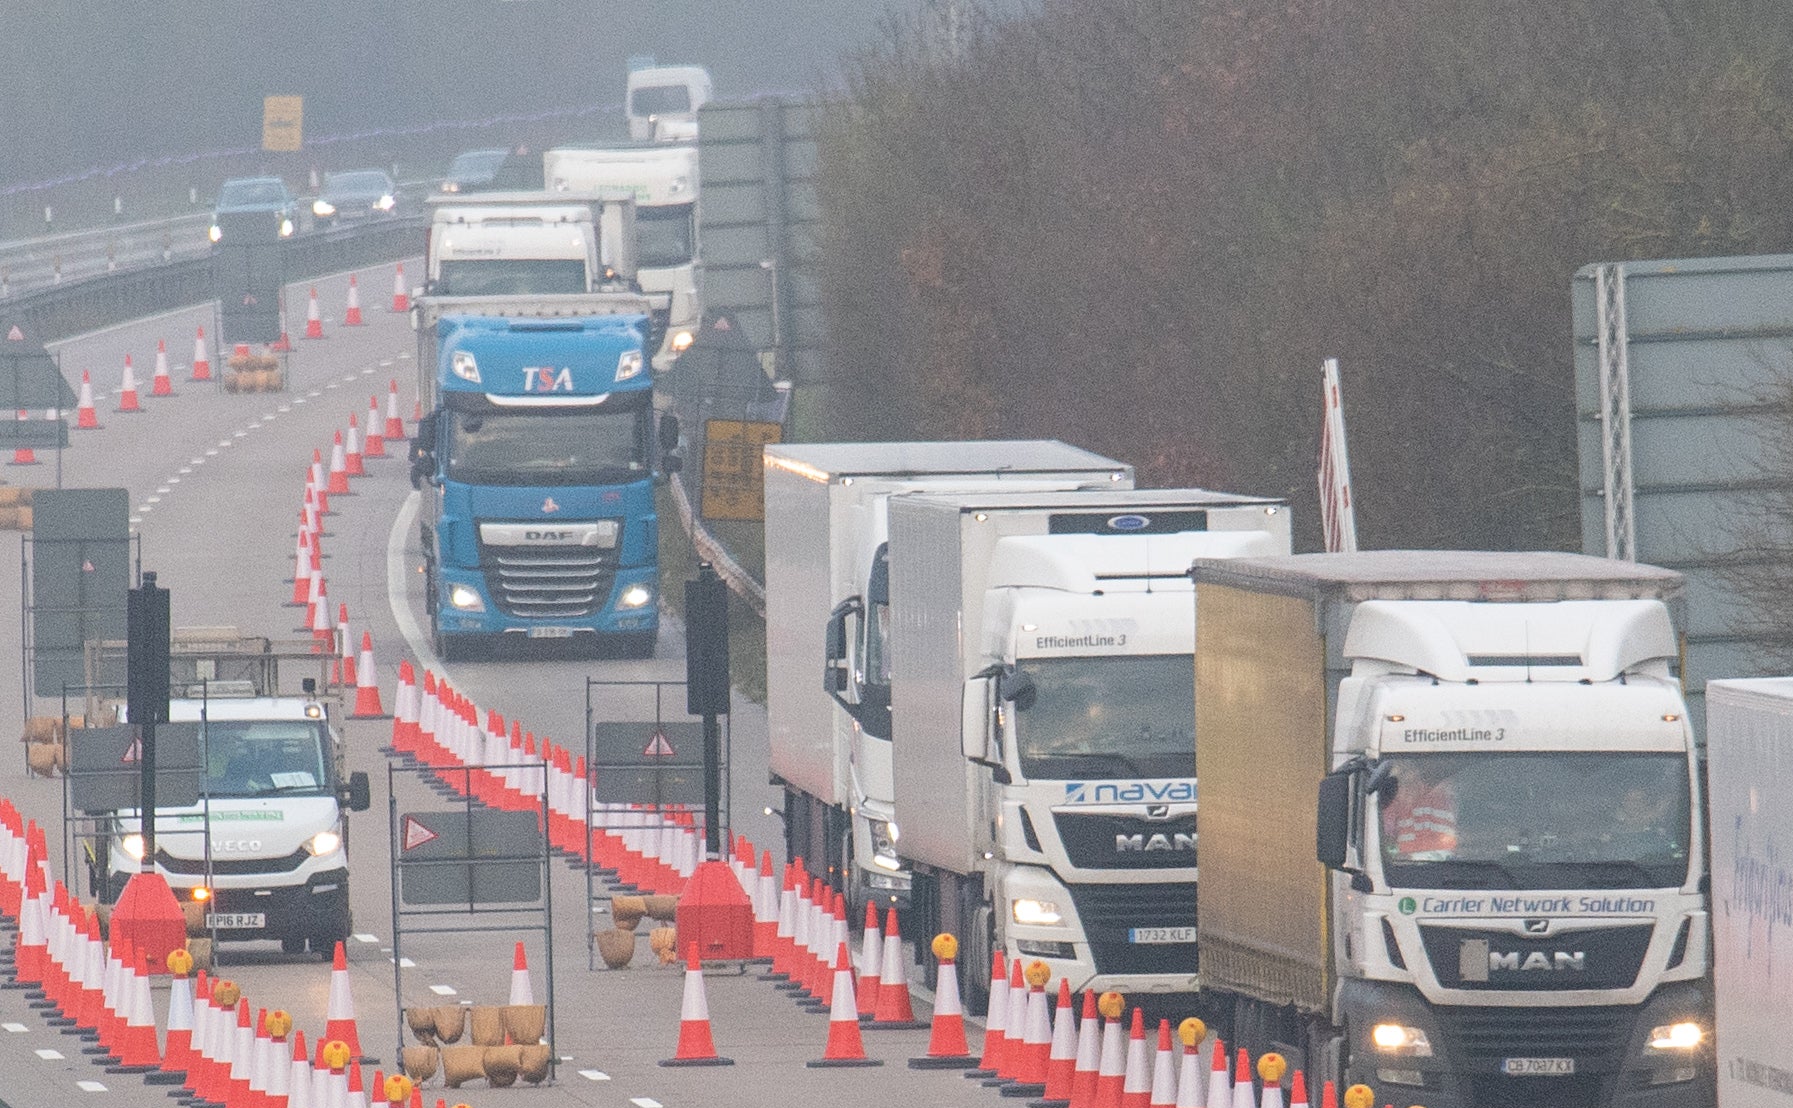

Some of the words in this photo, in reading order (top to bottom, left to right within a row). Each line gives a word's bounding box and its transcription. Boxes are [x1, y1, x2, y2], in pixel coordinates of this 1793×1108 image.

[522, 367, 574, 391] TSA
[525, 530, 573, 541] DAF
[1036, 635, 1114, 649] EfficientLine
[1117, 634, 1127, 646] 3
[1404, 729, 1491, 743] EfficientLine
[1495, 728, 1505, 741] 3
[1095, 782, 1197, 801] nava
[208, 839, 262, 853] VECO
[1115, 833, 1198, 851] MAN
[1423, 897, 1488, 913] Carrier
[1490, 897, 1571, 913] Network
[1578, 897, 1655, 913] Solution
[1138, 930, 1166, 941] 1732
[1489, 951, 1585, 971] MAN
